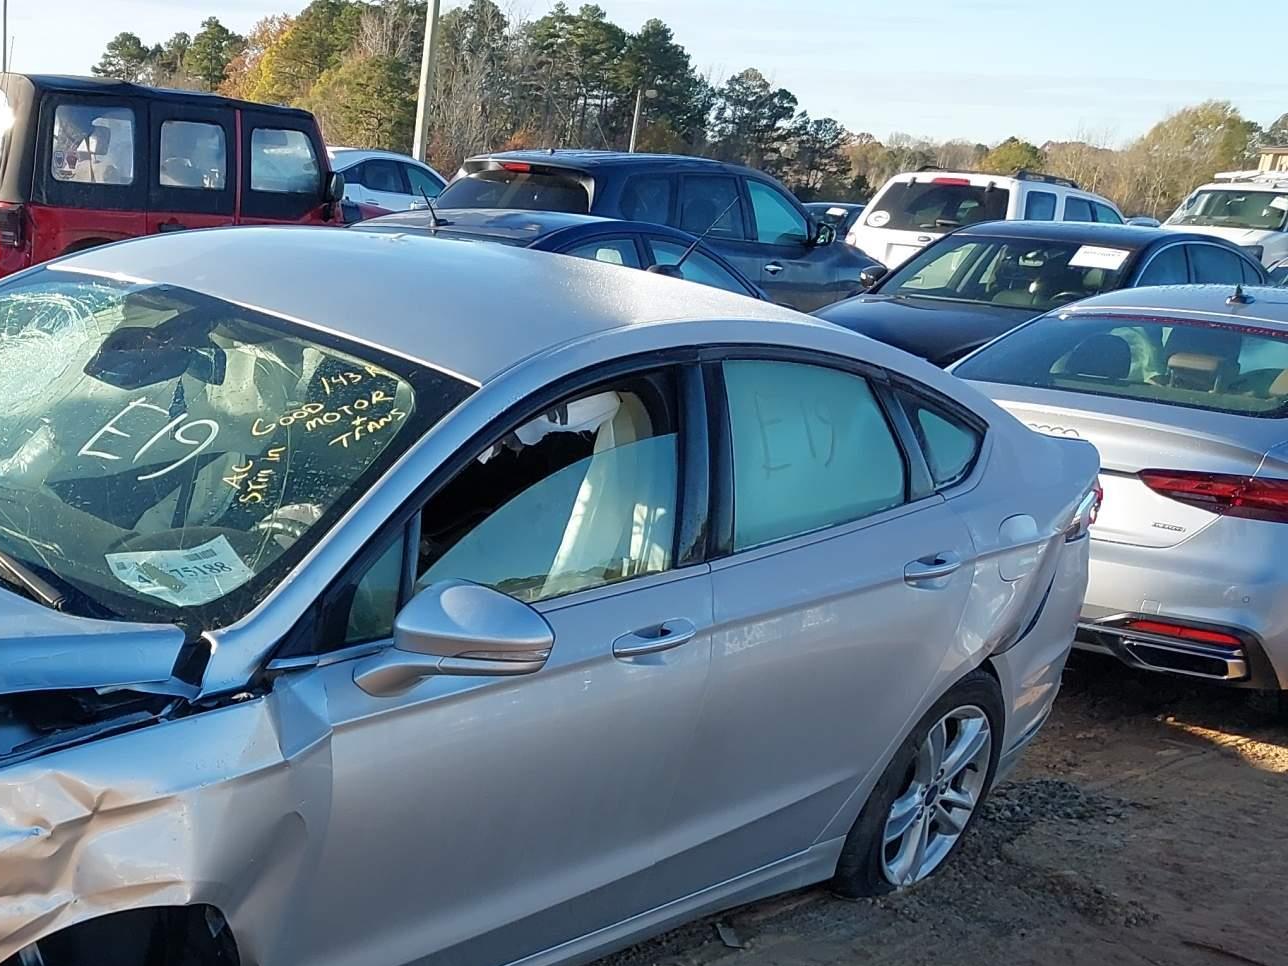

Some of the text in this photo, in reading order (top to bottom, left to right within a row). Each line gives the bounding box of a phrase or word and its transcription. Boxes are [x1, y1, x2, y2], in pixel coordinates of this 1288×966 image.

[251, 402, 324, 436] GOOD
[305, 390, 394, 431] MOTOR
[77, 397, 220, 482] E19
[222, 460, 253, 490] AC
